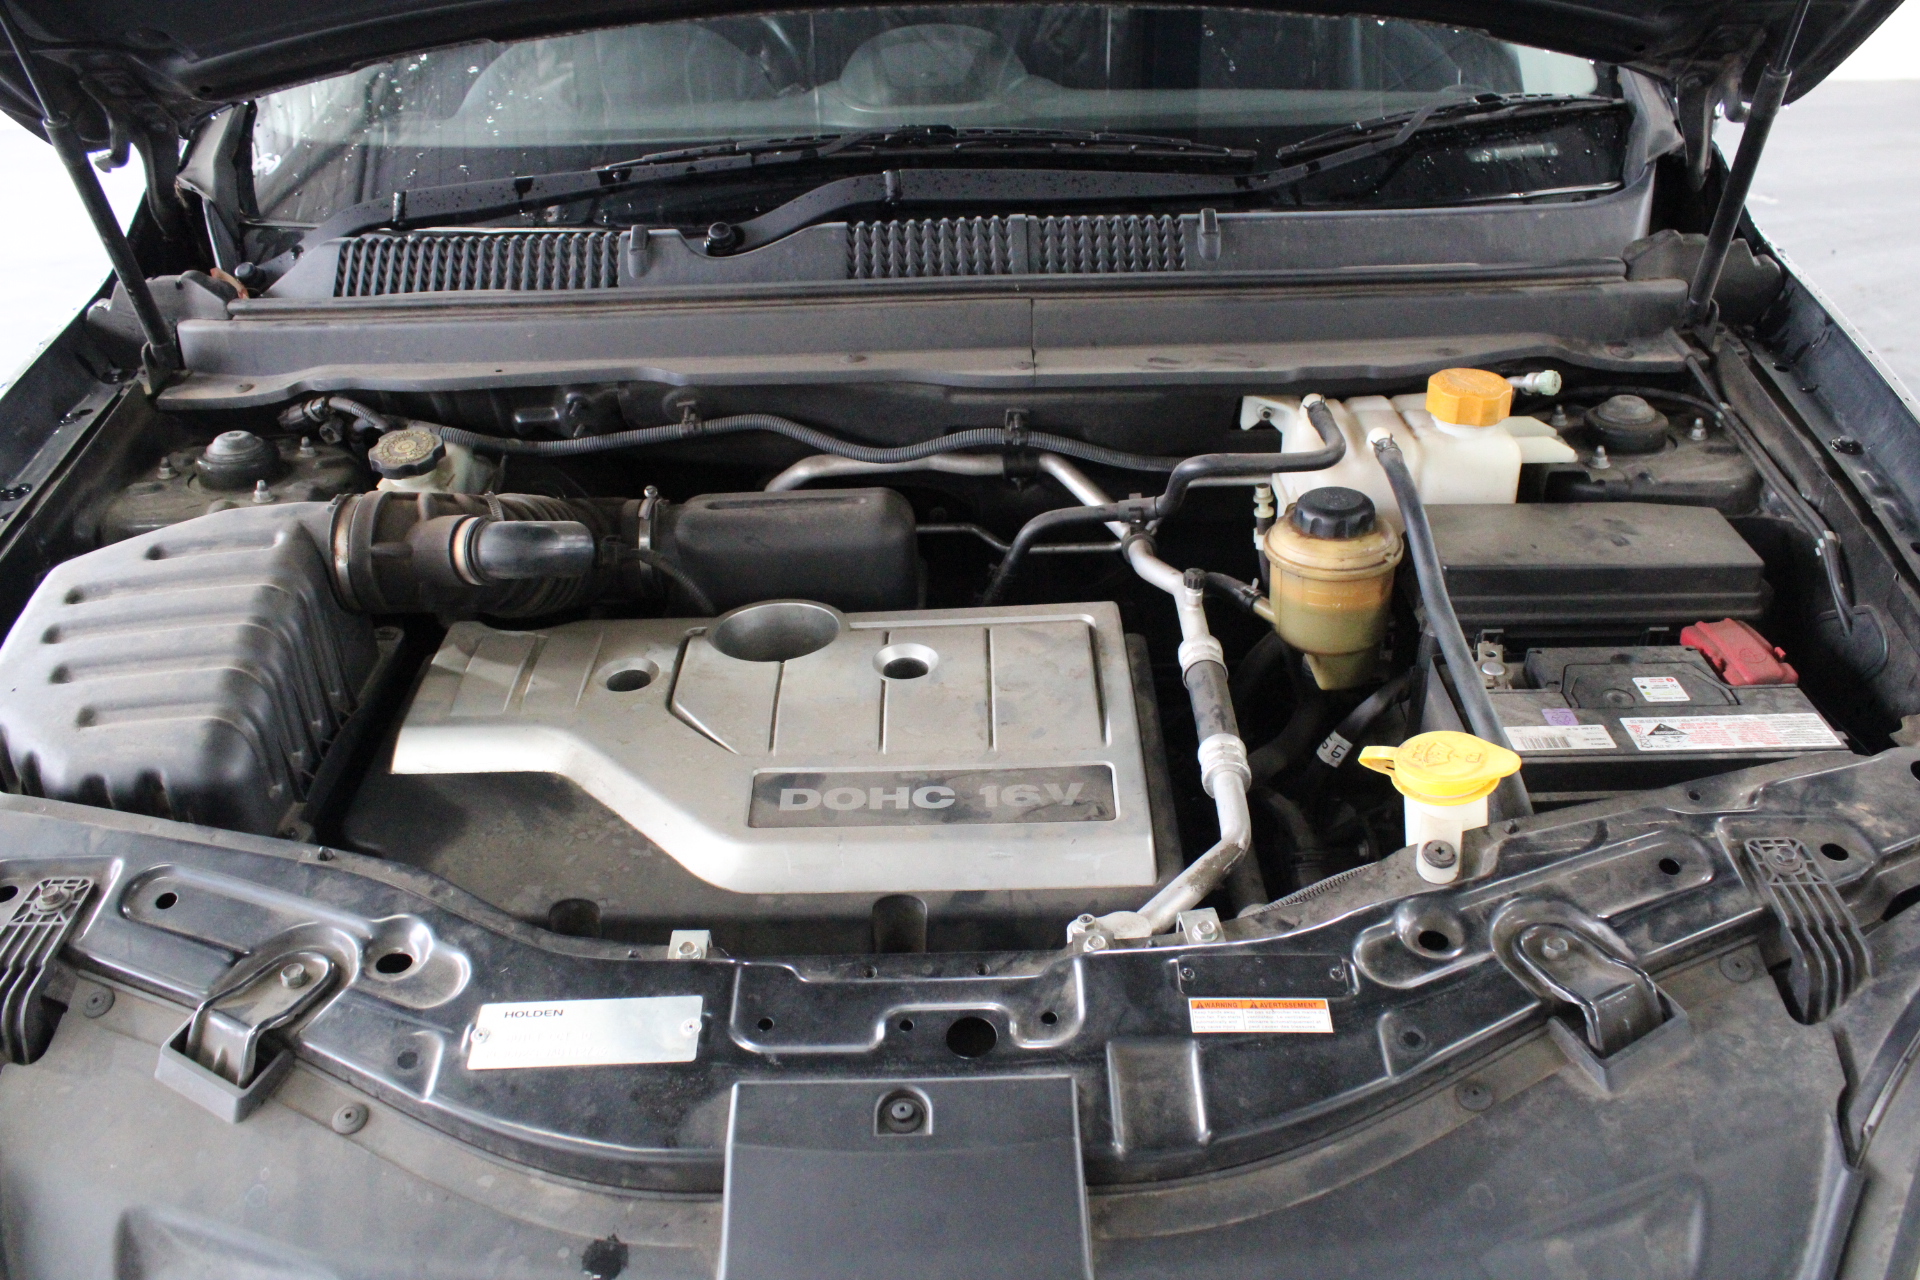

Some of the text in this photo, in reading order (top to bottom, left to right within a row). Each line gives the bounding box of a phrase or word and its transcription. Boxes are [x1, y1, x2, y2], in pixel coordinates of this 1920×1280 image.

[778, 782, 1085, 811] DOHC 16V
[504, 1009, 564, 1019] HOLDEN
